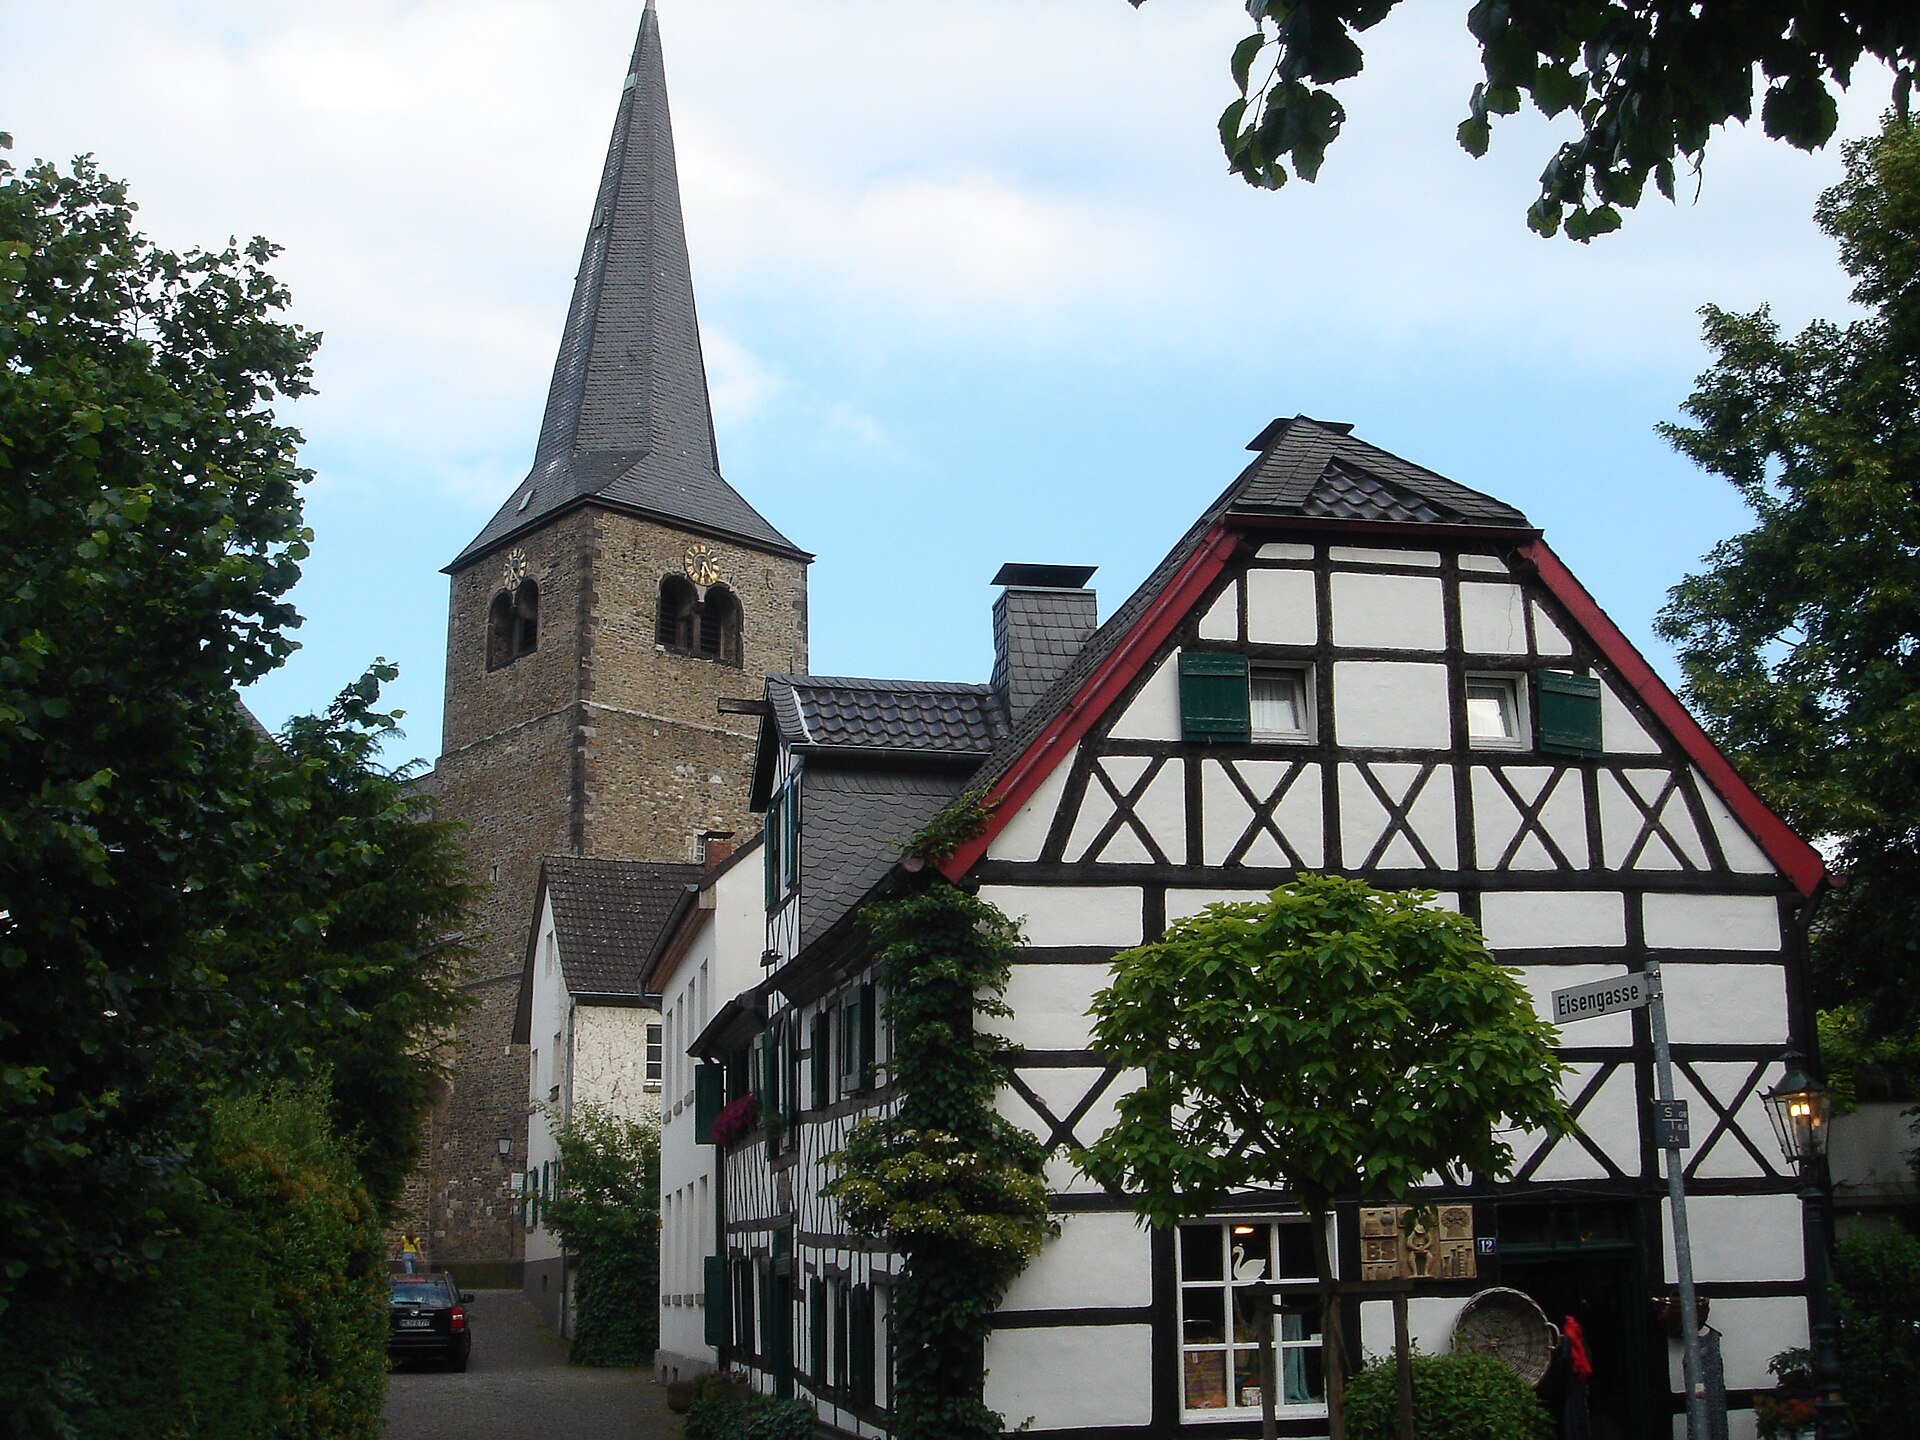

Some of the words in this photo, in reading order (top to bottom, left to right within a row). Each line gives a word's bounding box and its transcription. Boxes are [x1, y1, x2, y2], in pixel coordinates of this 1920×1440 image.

[1557, 985, 1639, 1015] Eisengasse
[1664, 1107, 1673, 1117] S
[1481, 1240, 1493, 1253] 12
